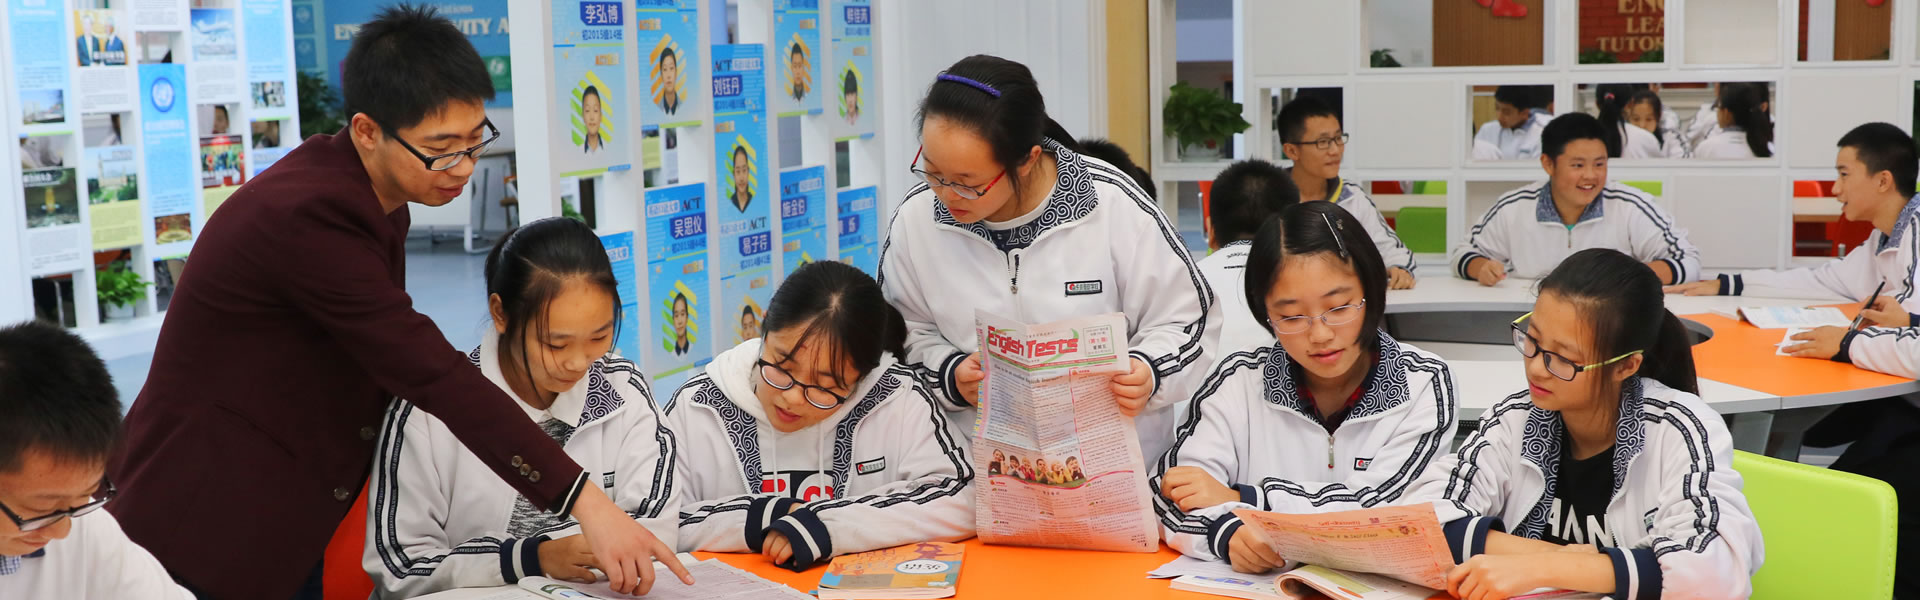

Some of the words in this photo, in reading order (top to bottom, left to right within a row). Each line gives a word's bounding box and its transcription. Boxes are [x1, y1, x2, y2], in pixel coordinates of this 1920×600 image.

[585, 4, 618, 24] 李弘博
[681, 197, 702, 213] ACT
[674, 216, 703, 239] 吴思仪
[749, 217, 767, 231] ACT
[988, 325, 1024, 356] English
[1026, 338, 1079, 358] Tests
